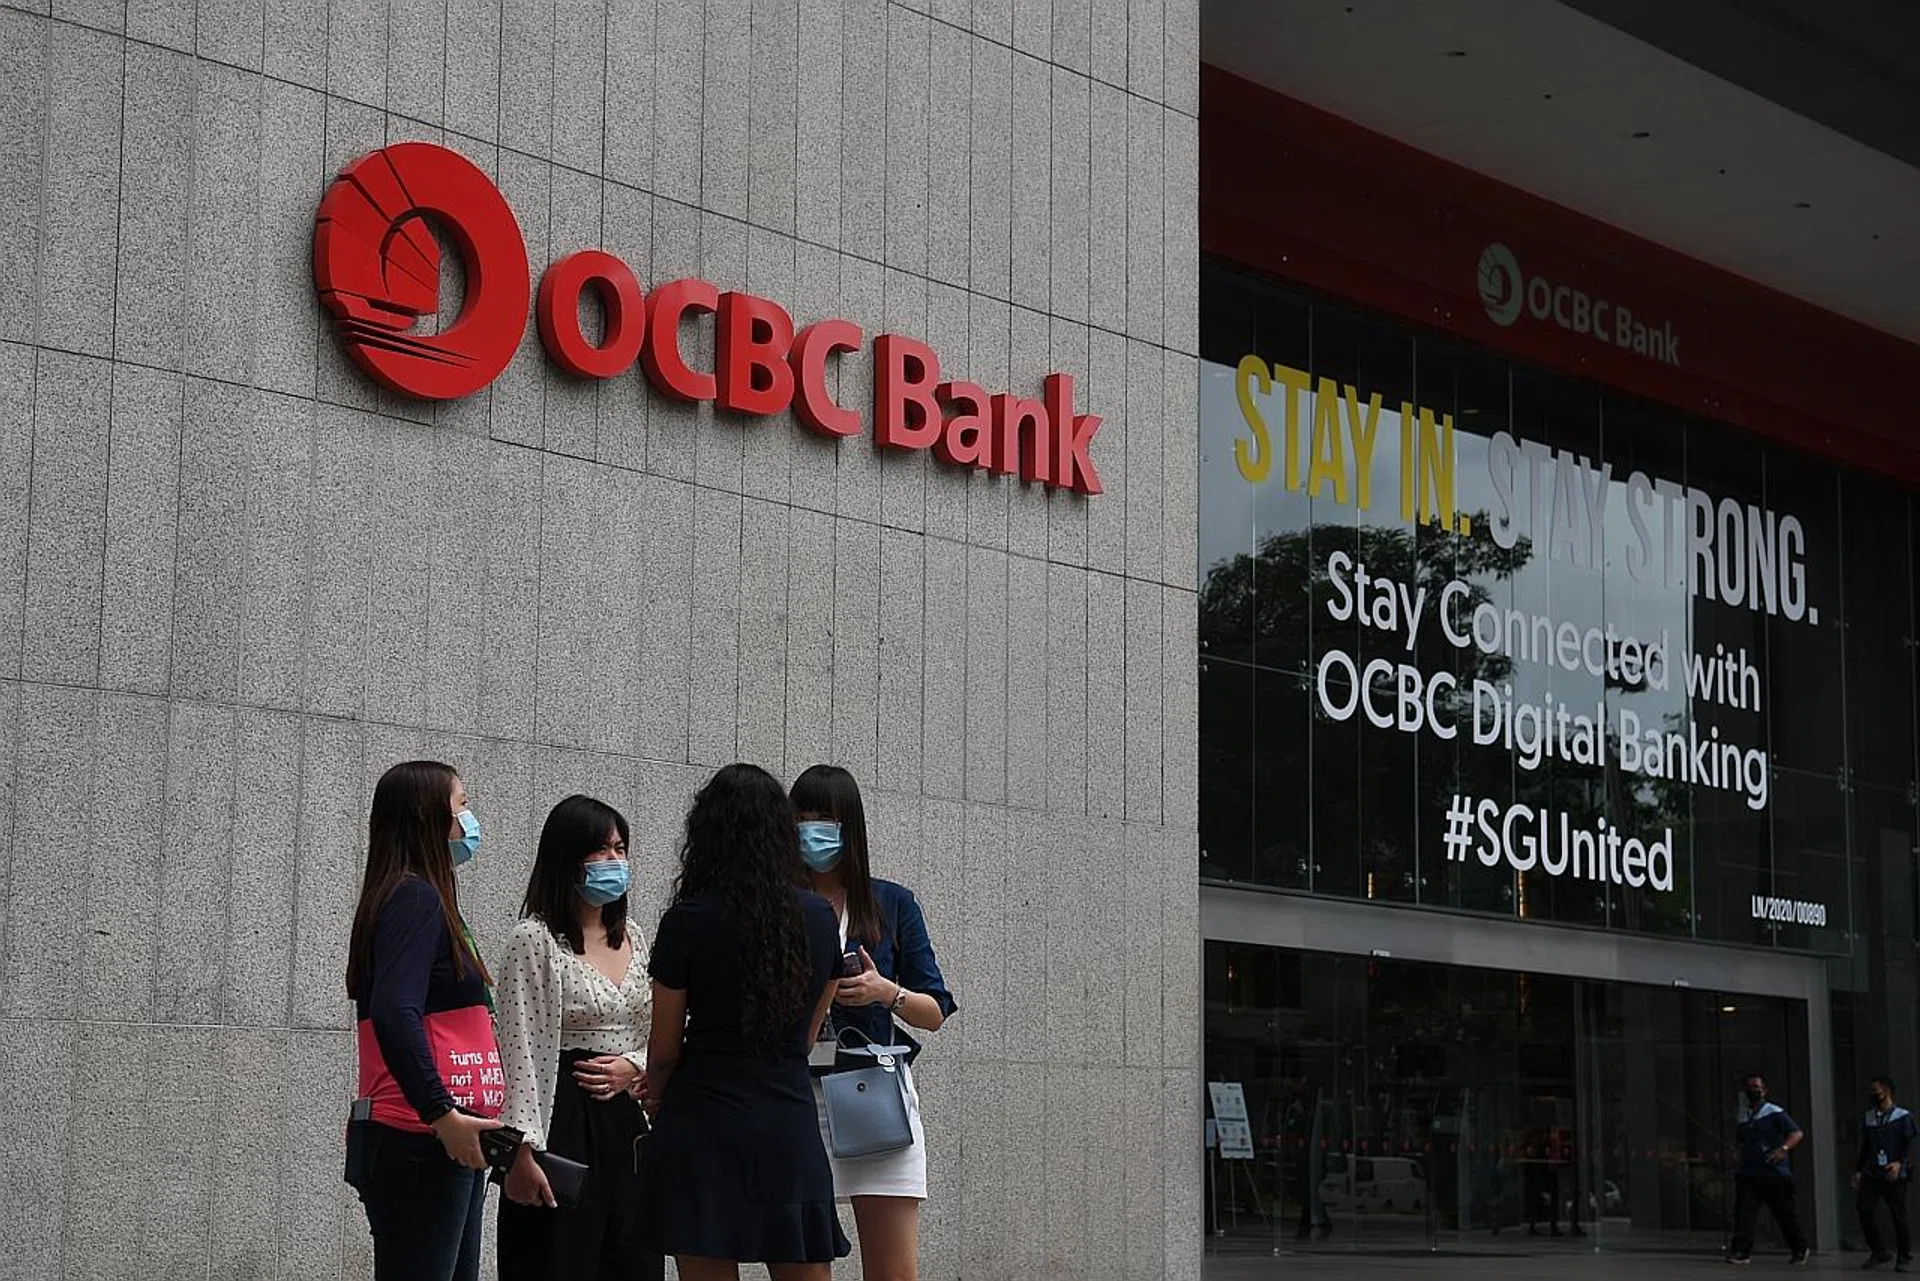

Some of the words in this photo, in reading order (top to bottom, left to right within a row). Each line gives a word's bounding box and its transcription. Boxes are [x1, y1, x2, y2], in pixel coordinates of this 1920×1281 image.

[538, 250, 864, 436] OCBC
[873, 333, 1104, 495] Bank
[1528, 276, 1610, 342] OCBC
[1616, 305, 1681, 367] Bank
[1234, 354, 1383, 510] STAY
[1400, 400, 1472, 536] IN.
[1487, 430, 1613, 572] STAY
[1625, 470, 1819, 626] STRONG.
[1327, 550, 1425, 651] Stay
[1440, 580, 1669, 691] Connected
[1681, 643, 1761, 713] with
[1317, 649, 1458, 740] OCBC
[1472, 678, 1606, 770] Digital
[1619, 708, 1769, 811] Banking
[1443, 794, 1675, 892] #SGUnited
[449, 1050, 483, 1065] turns
[451, 1070, 472, 1086] not
